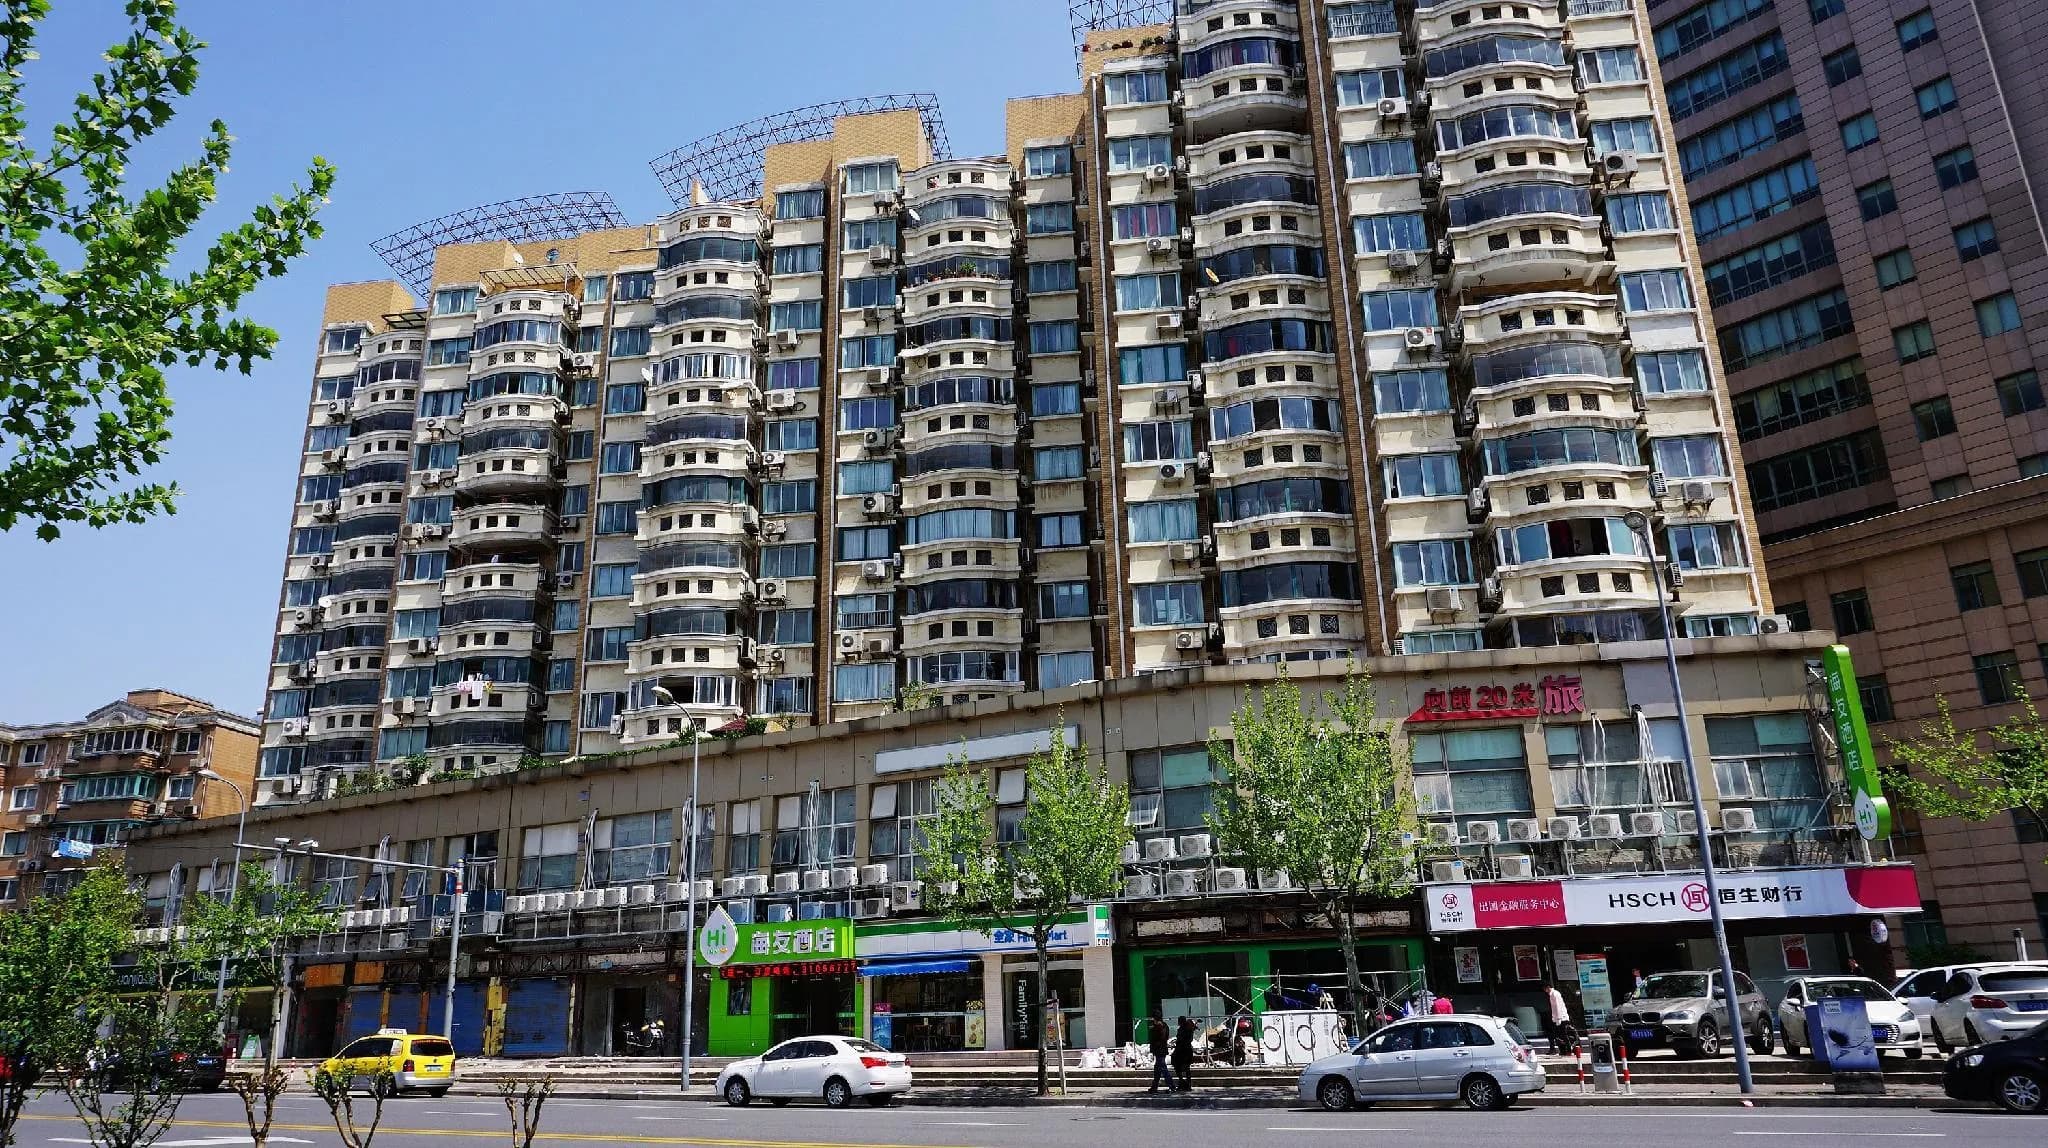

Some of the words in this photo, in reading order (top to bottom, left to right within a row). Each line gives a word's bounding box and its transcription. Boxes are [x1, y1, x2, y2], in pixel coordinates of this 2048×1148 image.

[1858, 803, 1873, 825] Hi
[1479, 898, 1560, 912] 出国金融服务中心
[1609, 891, 1676, 908] HSCH
[1717, 886, 1803, 905] 恒生财行
[707, 925, 727, 947] Hi
[993, 930, 1014, 943] 全家
[1018, 979, 1029, 1039] FamilyMart
